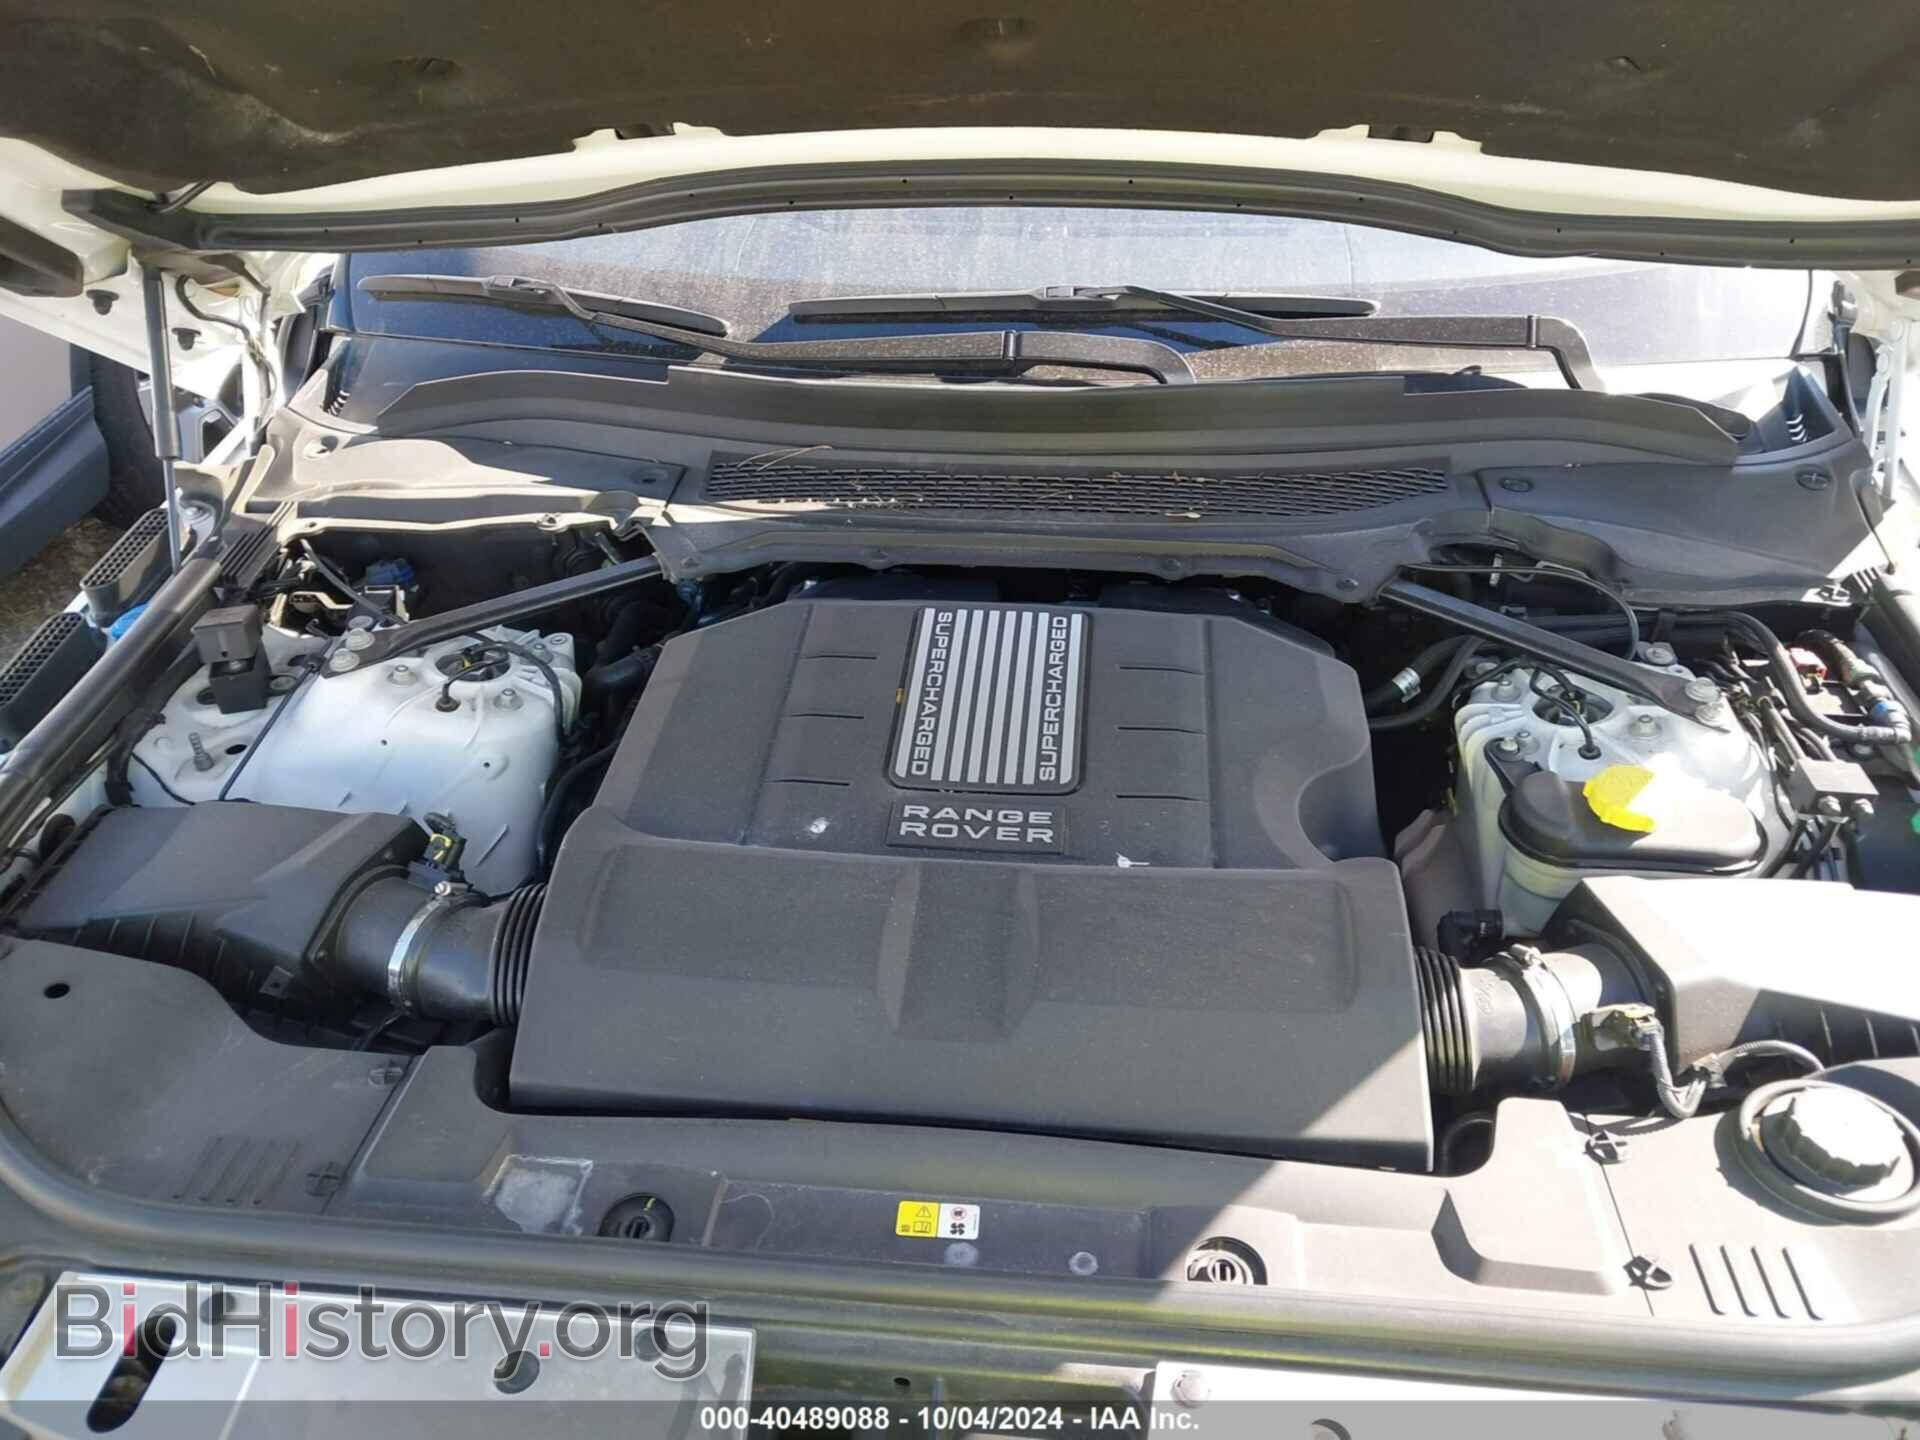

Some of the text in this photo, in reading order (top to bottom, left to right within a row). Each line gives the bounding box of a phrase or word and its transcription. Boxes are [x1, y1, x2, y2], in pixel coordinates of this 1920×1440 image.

[911, 612, 953, 775] SUPERCHARGED
[1039, 616, 1068, 781] SUPERCHARGED
[900, 822, 1054, 843] ROVER
[903, 804, 1053, 824] RANGE
